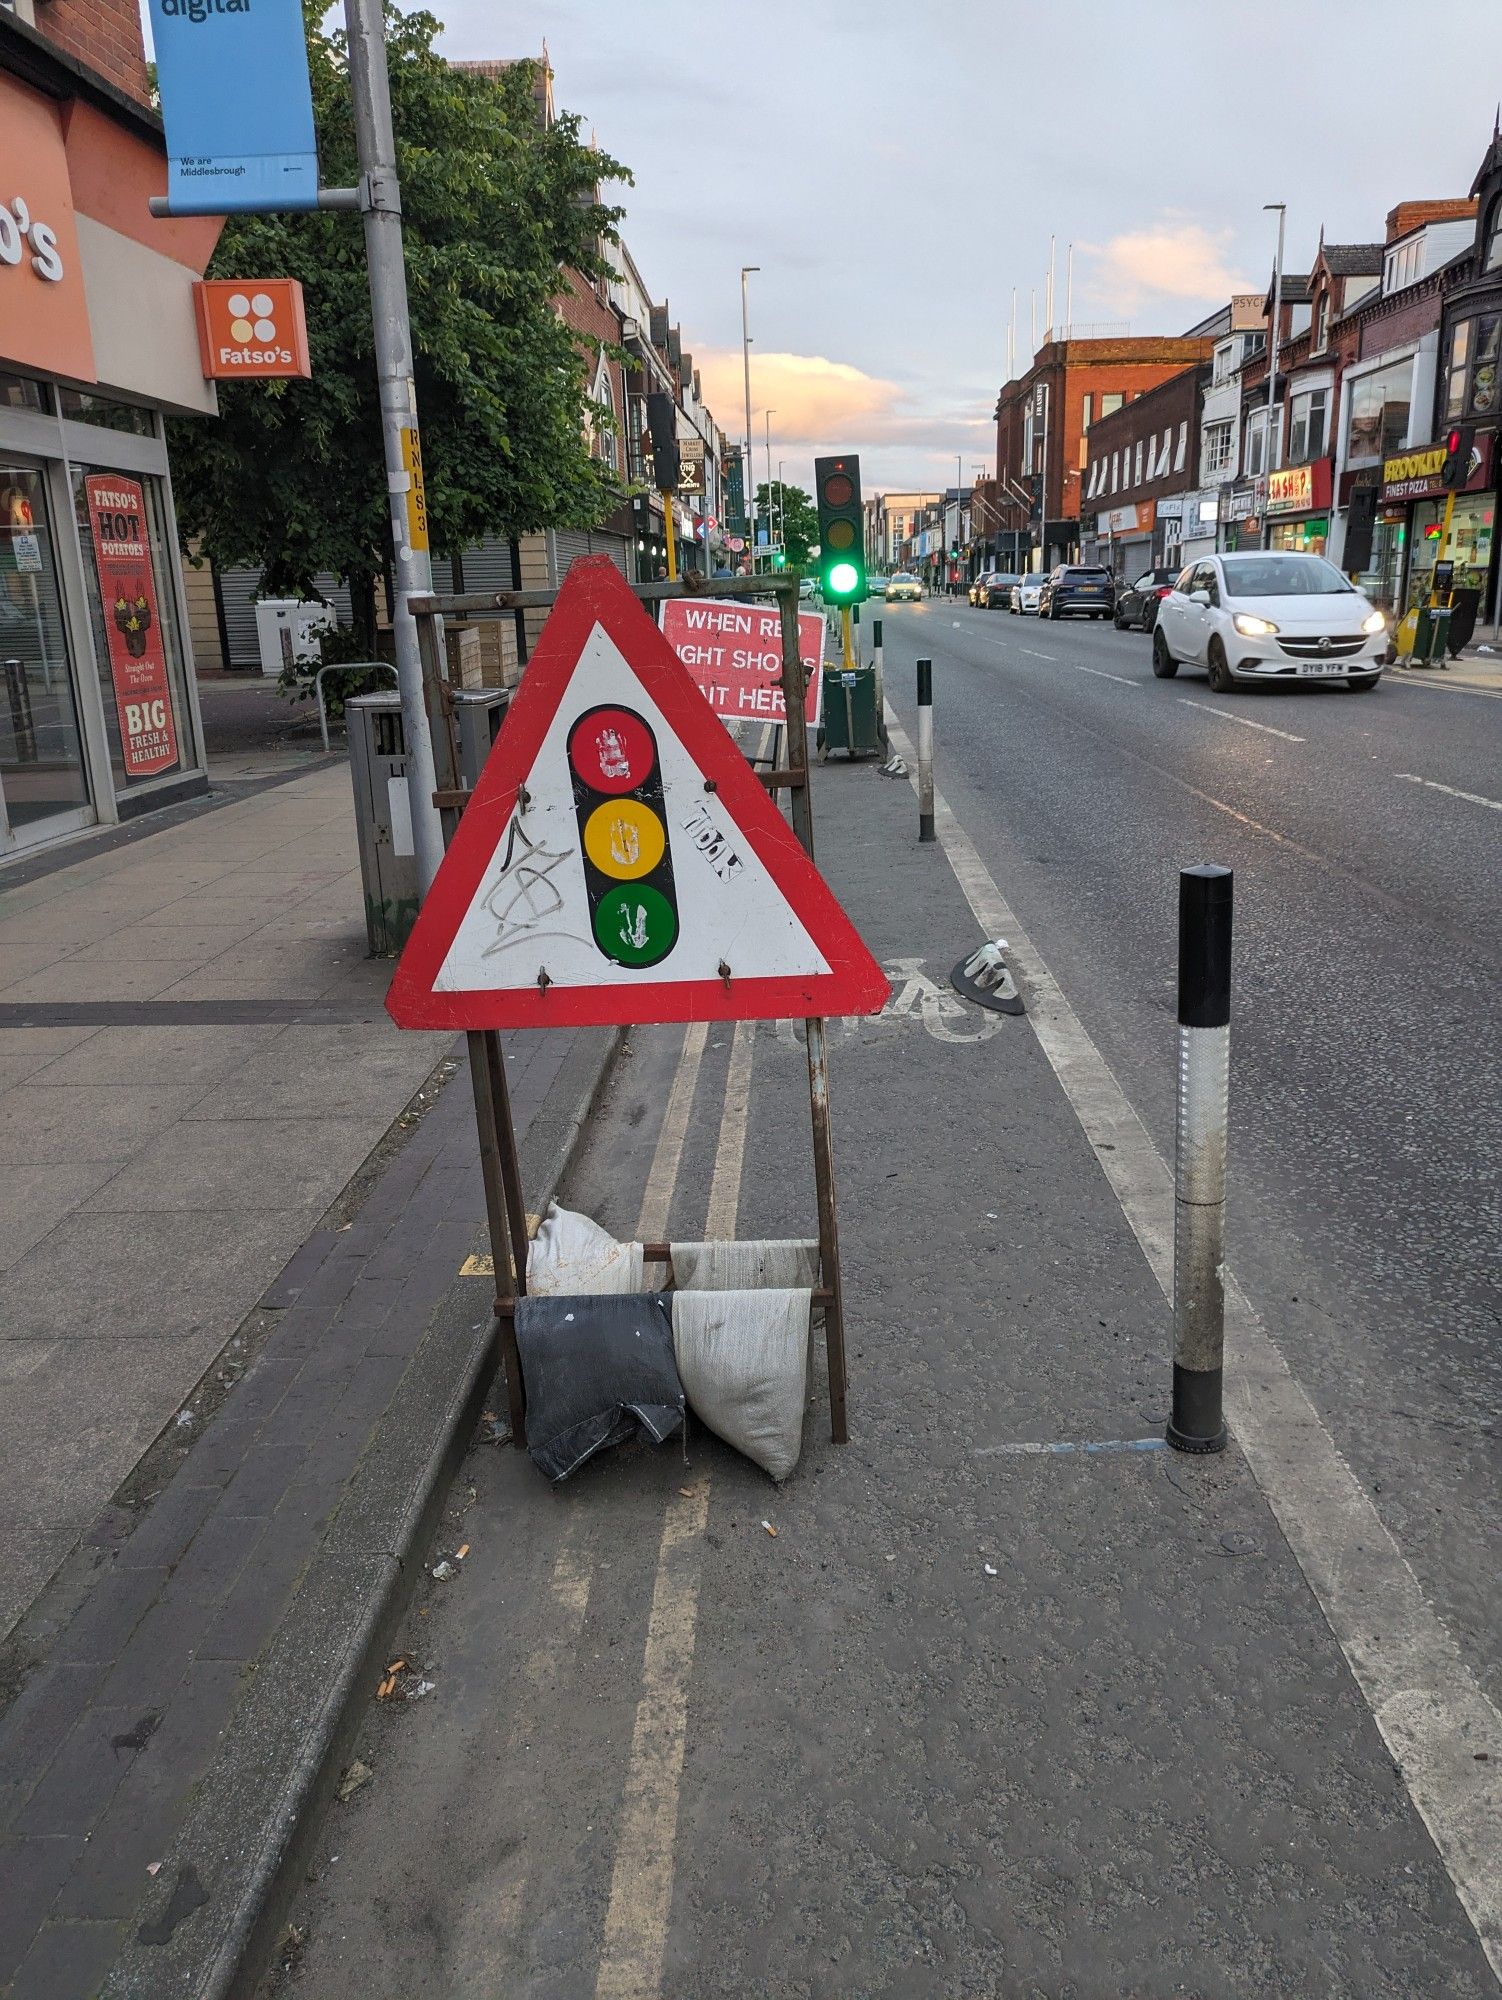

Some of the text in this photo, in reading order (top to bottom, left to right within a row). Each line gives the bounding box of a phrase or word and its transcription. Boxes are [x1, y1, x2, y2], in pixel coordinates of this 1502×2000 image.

[180, 157, 212, 166] We are
[180, 166, 246, 176] Middlesbrough
[220, 346, 292, 365] Fatso's
[1384, 448, 1447, 482] BROOKLY
[1386, 482, 1408, 497] FINEST
[1408, 479, 1428, 495] PIZZA
[94, 490, 138, 509] FATSO'S
[97, 511, 140, 543] HOT
[102, 542, 144, 556] POTATOES
[685, 609, 802, 638] WHEN RE
[675, 645, 817, 676] IGHT SHOS
[130, 675, 139, 684] The
[699, 685, 787, 712] IT HER
[124, 700, 166, 735] BIG
[129, 730, 169, 749] FRESH &
[131, 744, 170, 764] HEALTHY
